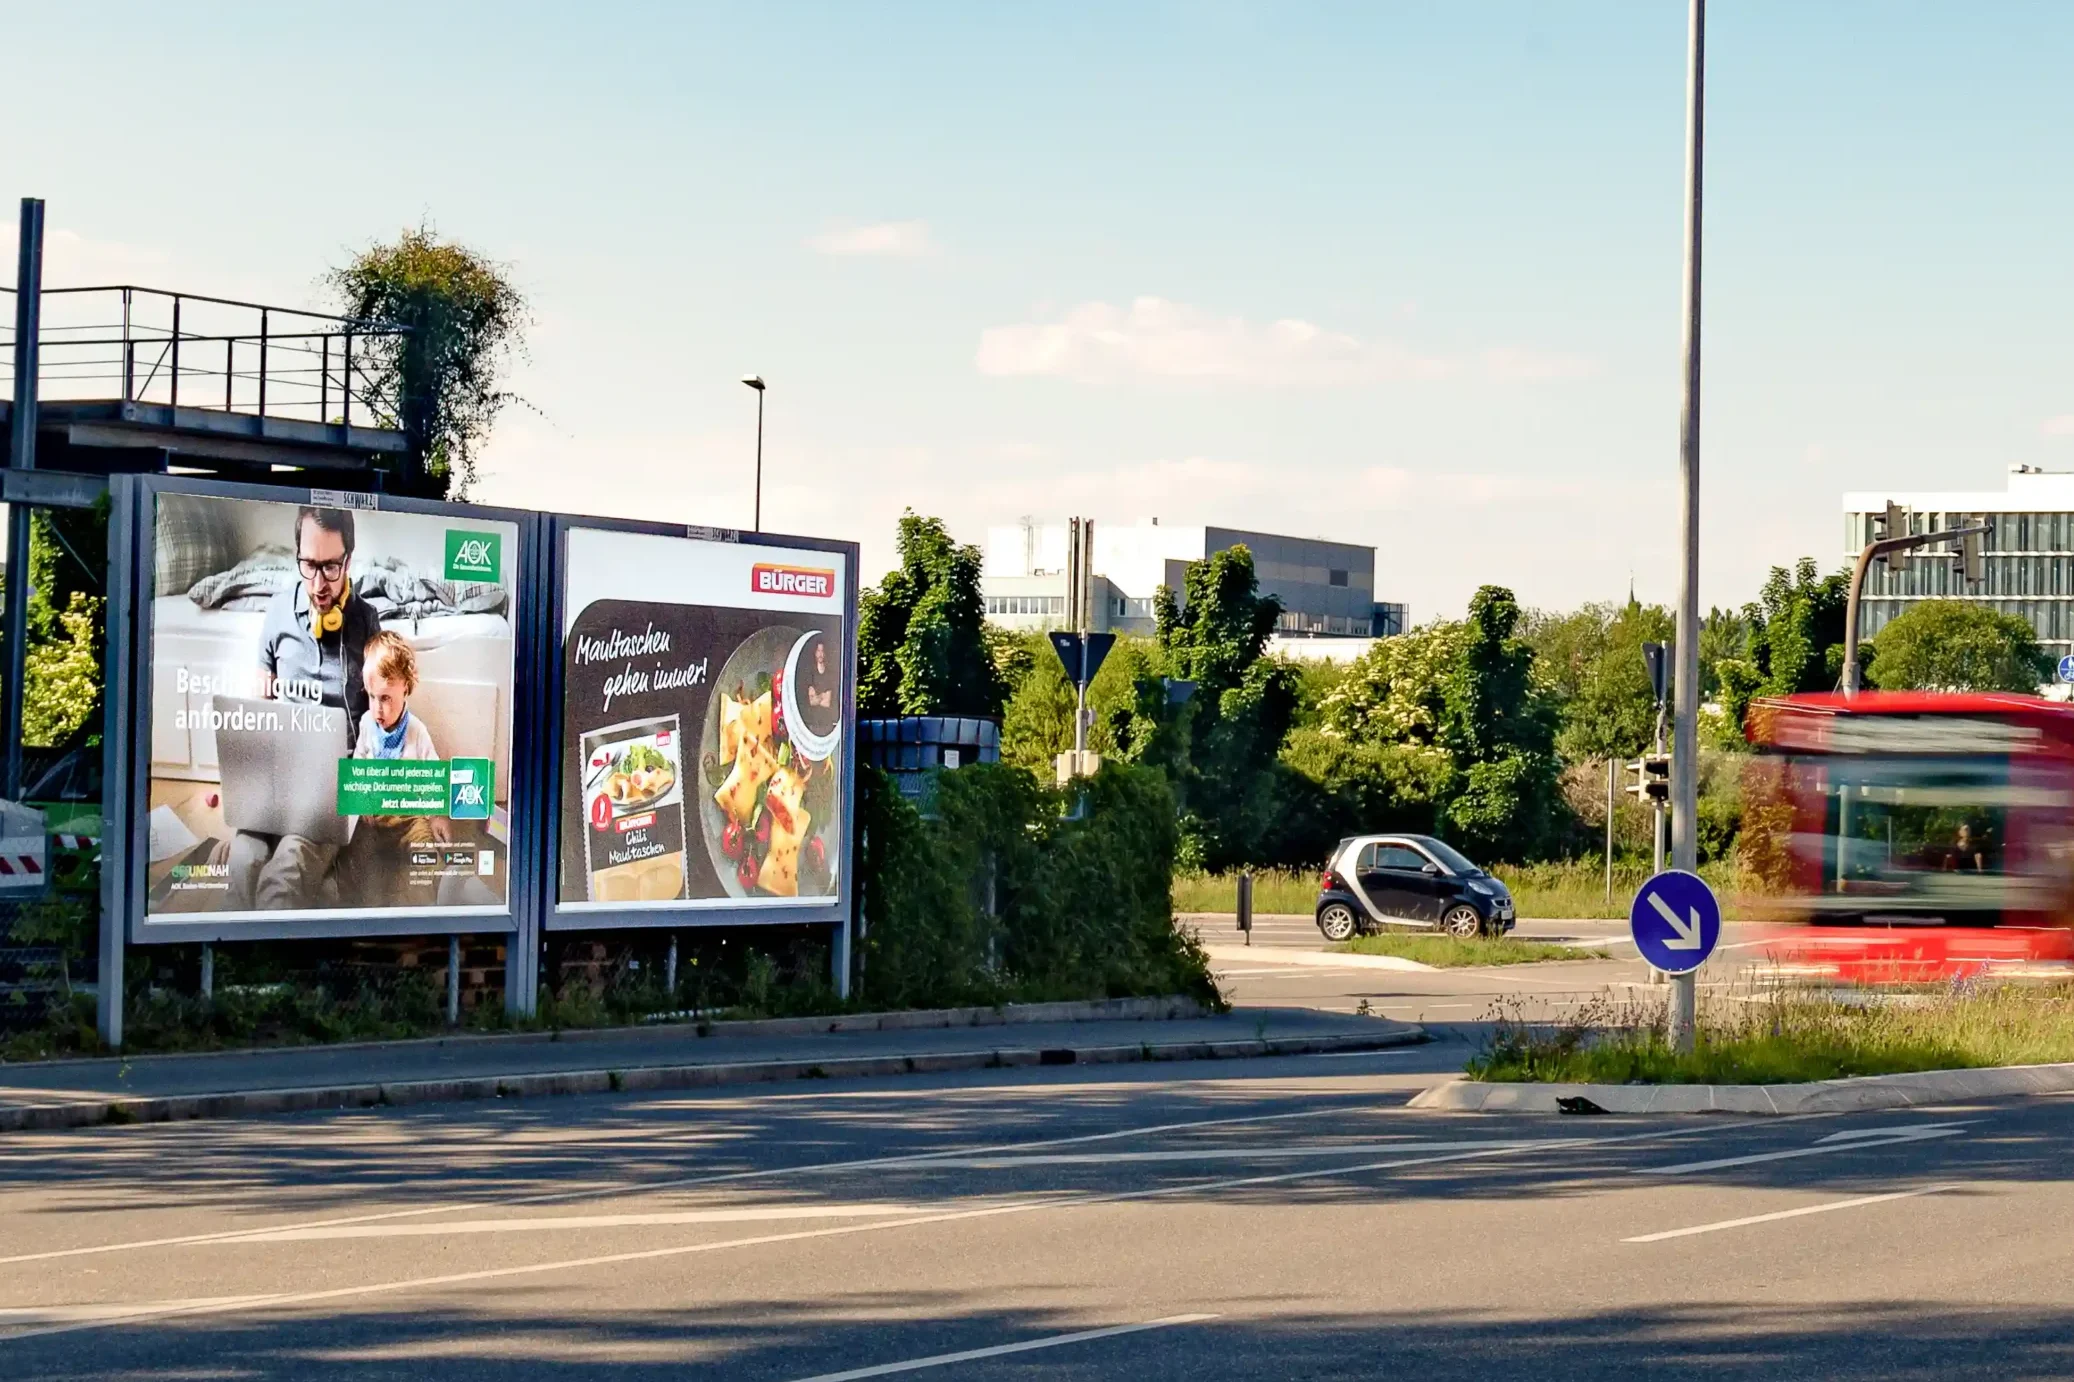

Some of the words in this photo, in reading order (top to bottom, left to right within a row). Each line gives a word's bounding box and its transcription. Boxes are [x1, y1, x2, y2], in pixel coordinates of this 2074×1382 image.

[454, 540, 492, 565] AOK
[759, 568, 828, 594] BÜRGER
[574, 621, 670, 665] Maultaschen
[603, 662, 649, 713] gehen
[653, 657, 708, 691] immer!
[174, 703, 284, 731] anfordern.
[290, 706, 337, 733] Klick.
[352, 766, 365, 777] Von
[390, 766, 404, 777] und
[434, 768, 445, 778] auf
[373, 782, 411, 793] Dokumente
[454, 785, 485, 805] AOK
[625, 828, 648, 845] Chili
